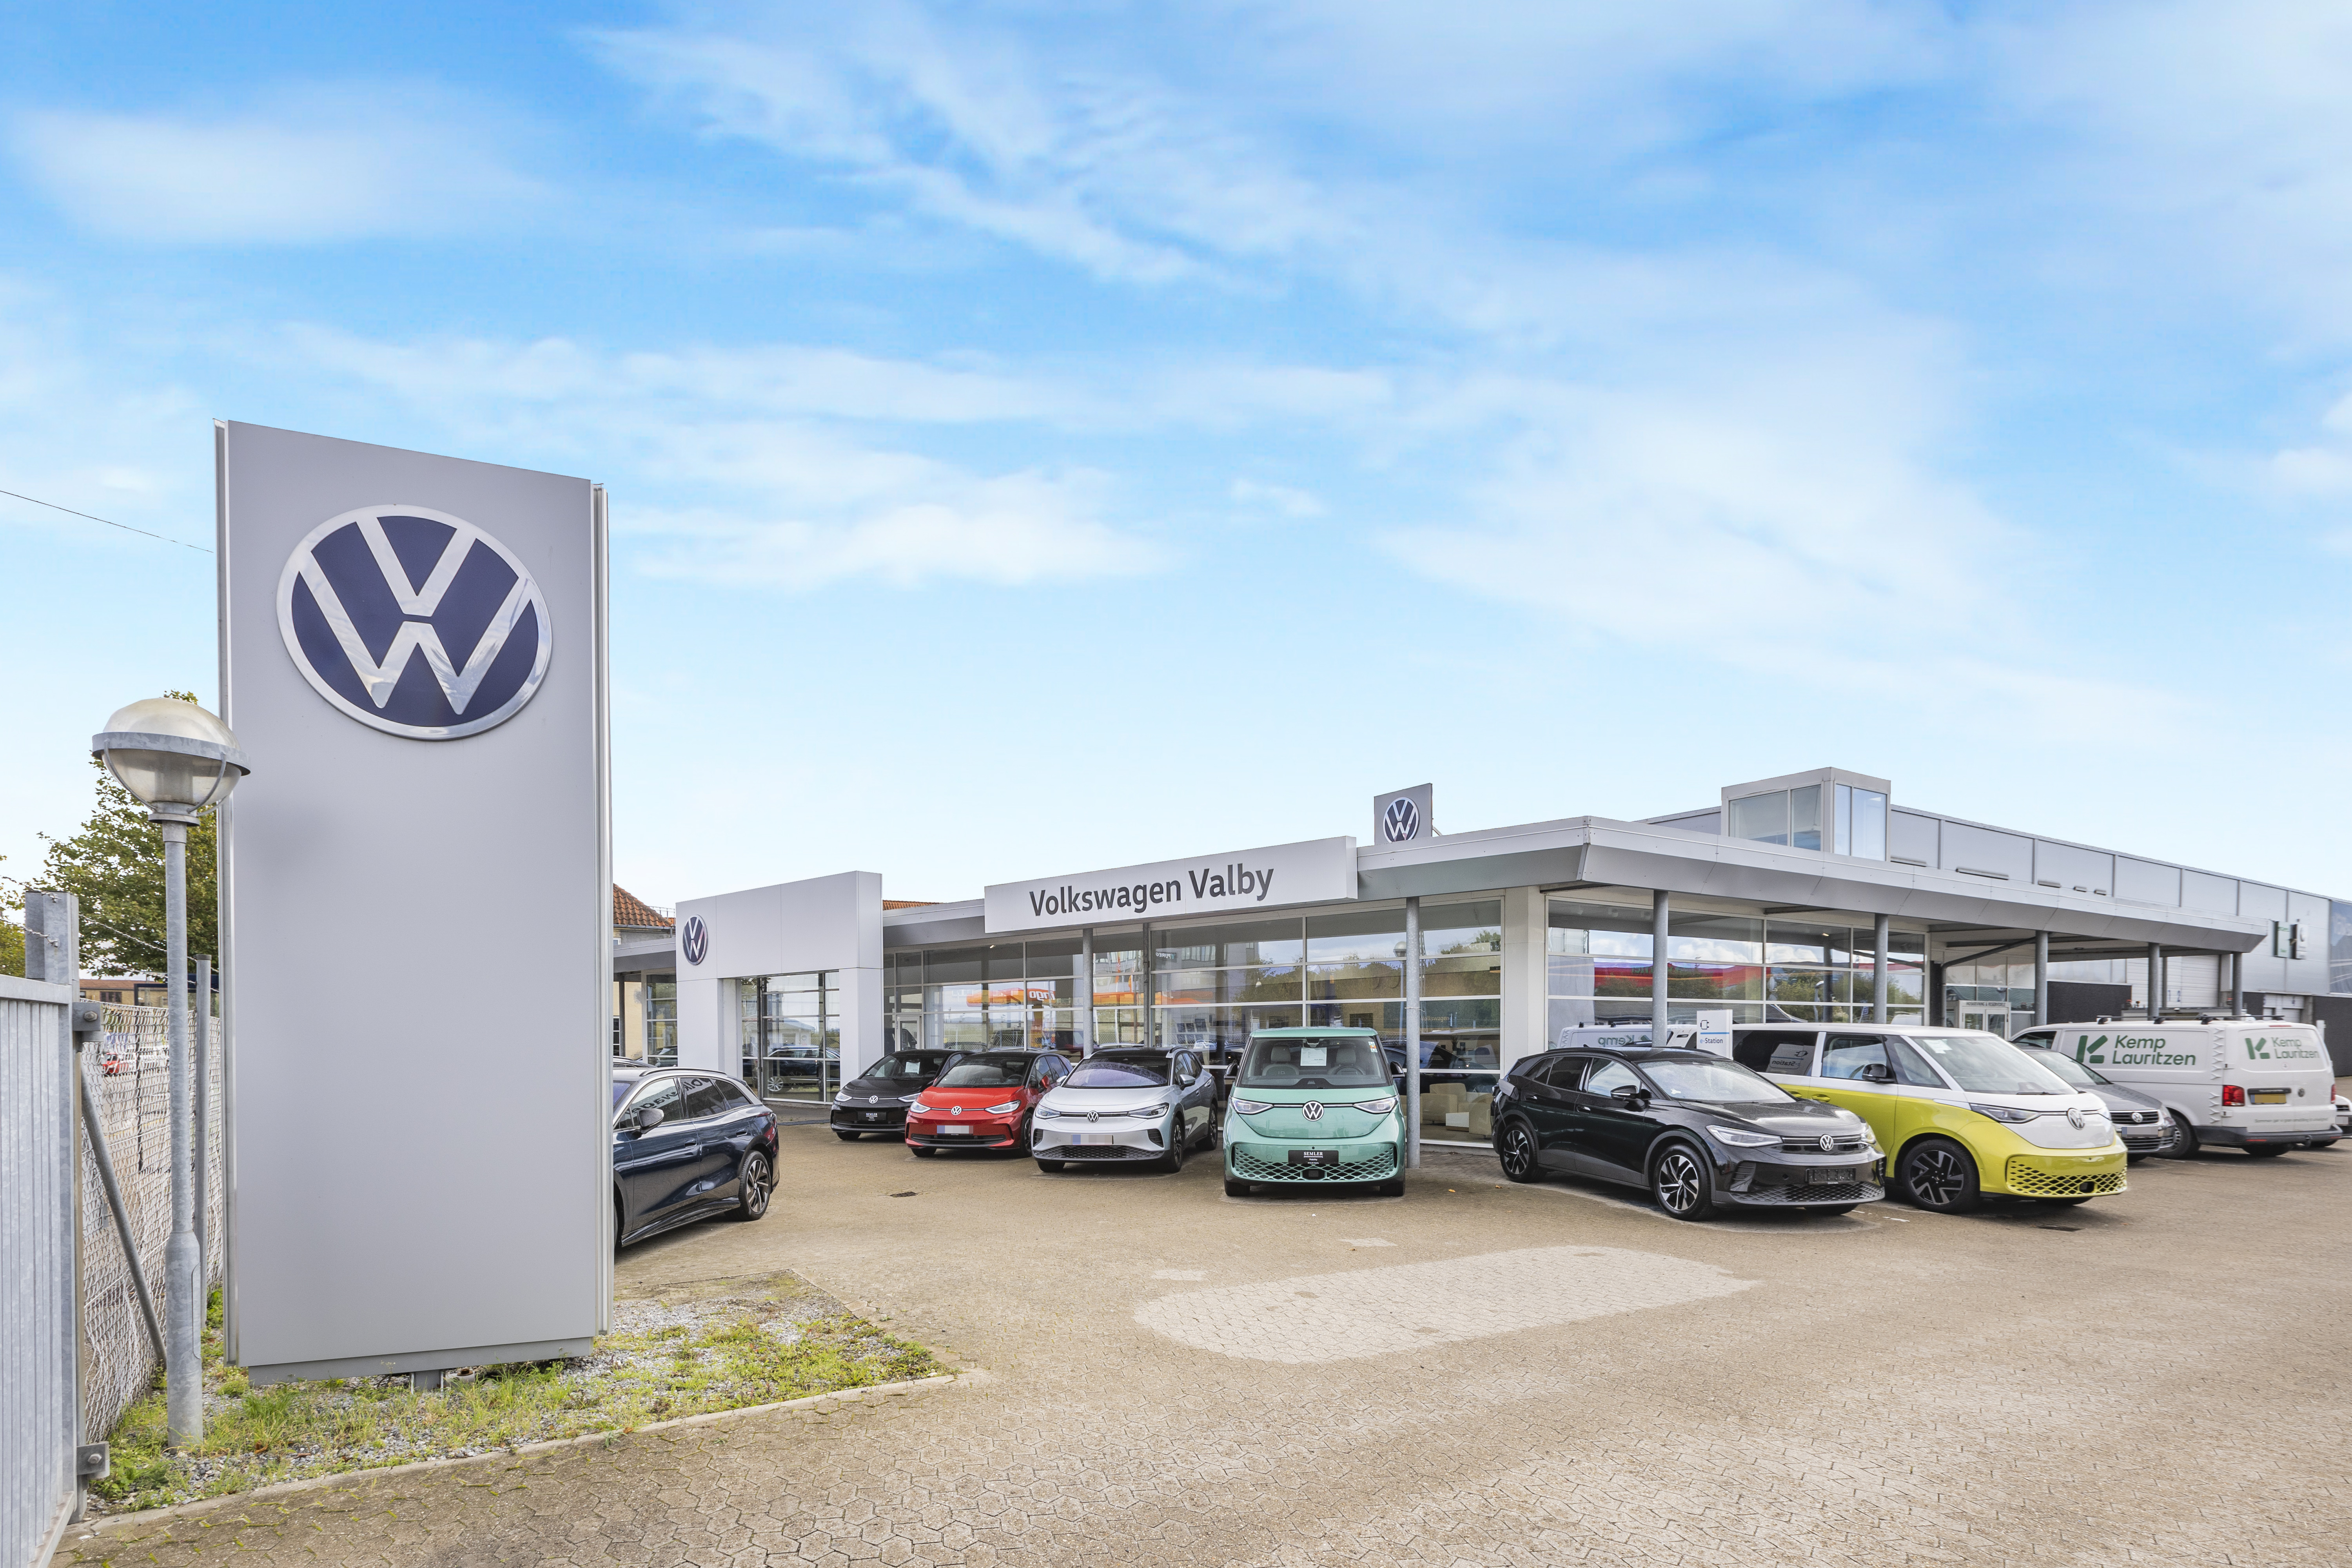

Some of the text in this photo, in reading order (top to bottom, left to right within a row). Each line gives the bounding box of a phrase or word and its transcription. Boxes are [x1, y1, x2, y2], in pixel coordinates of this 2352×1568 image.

[286, 510, 543, 727] VW
[1384, 798, 1419, 842] VW
[1029, 863, 1274, 916] Volkswagen Valby
[683, 915, 707, 964] VW
[2115, 1035, 2166, 1053] Kemp
[2271, 1037, 2302, 1051] Kemp
[2112, 1050, 2196, 1065] Lauritzen
[2274, 1048, 2320, 1059] Lauritzen
[951, 1105, 962, 1116] VW
[1087, 1111, 1099, 1123] VW
[1303, 1101, 1323, 1121] VW
[1820, 1134, 1834, 1151] VW
